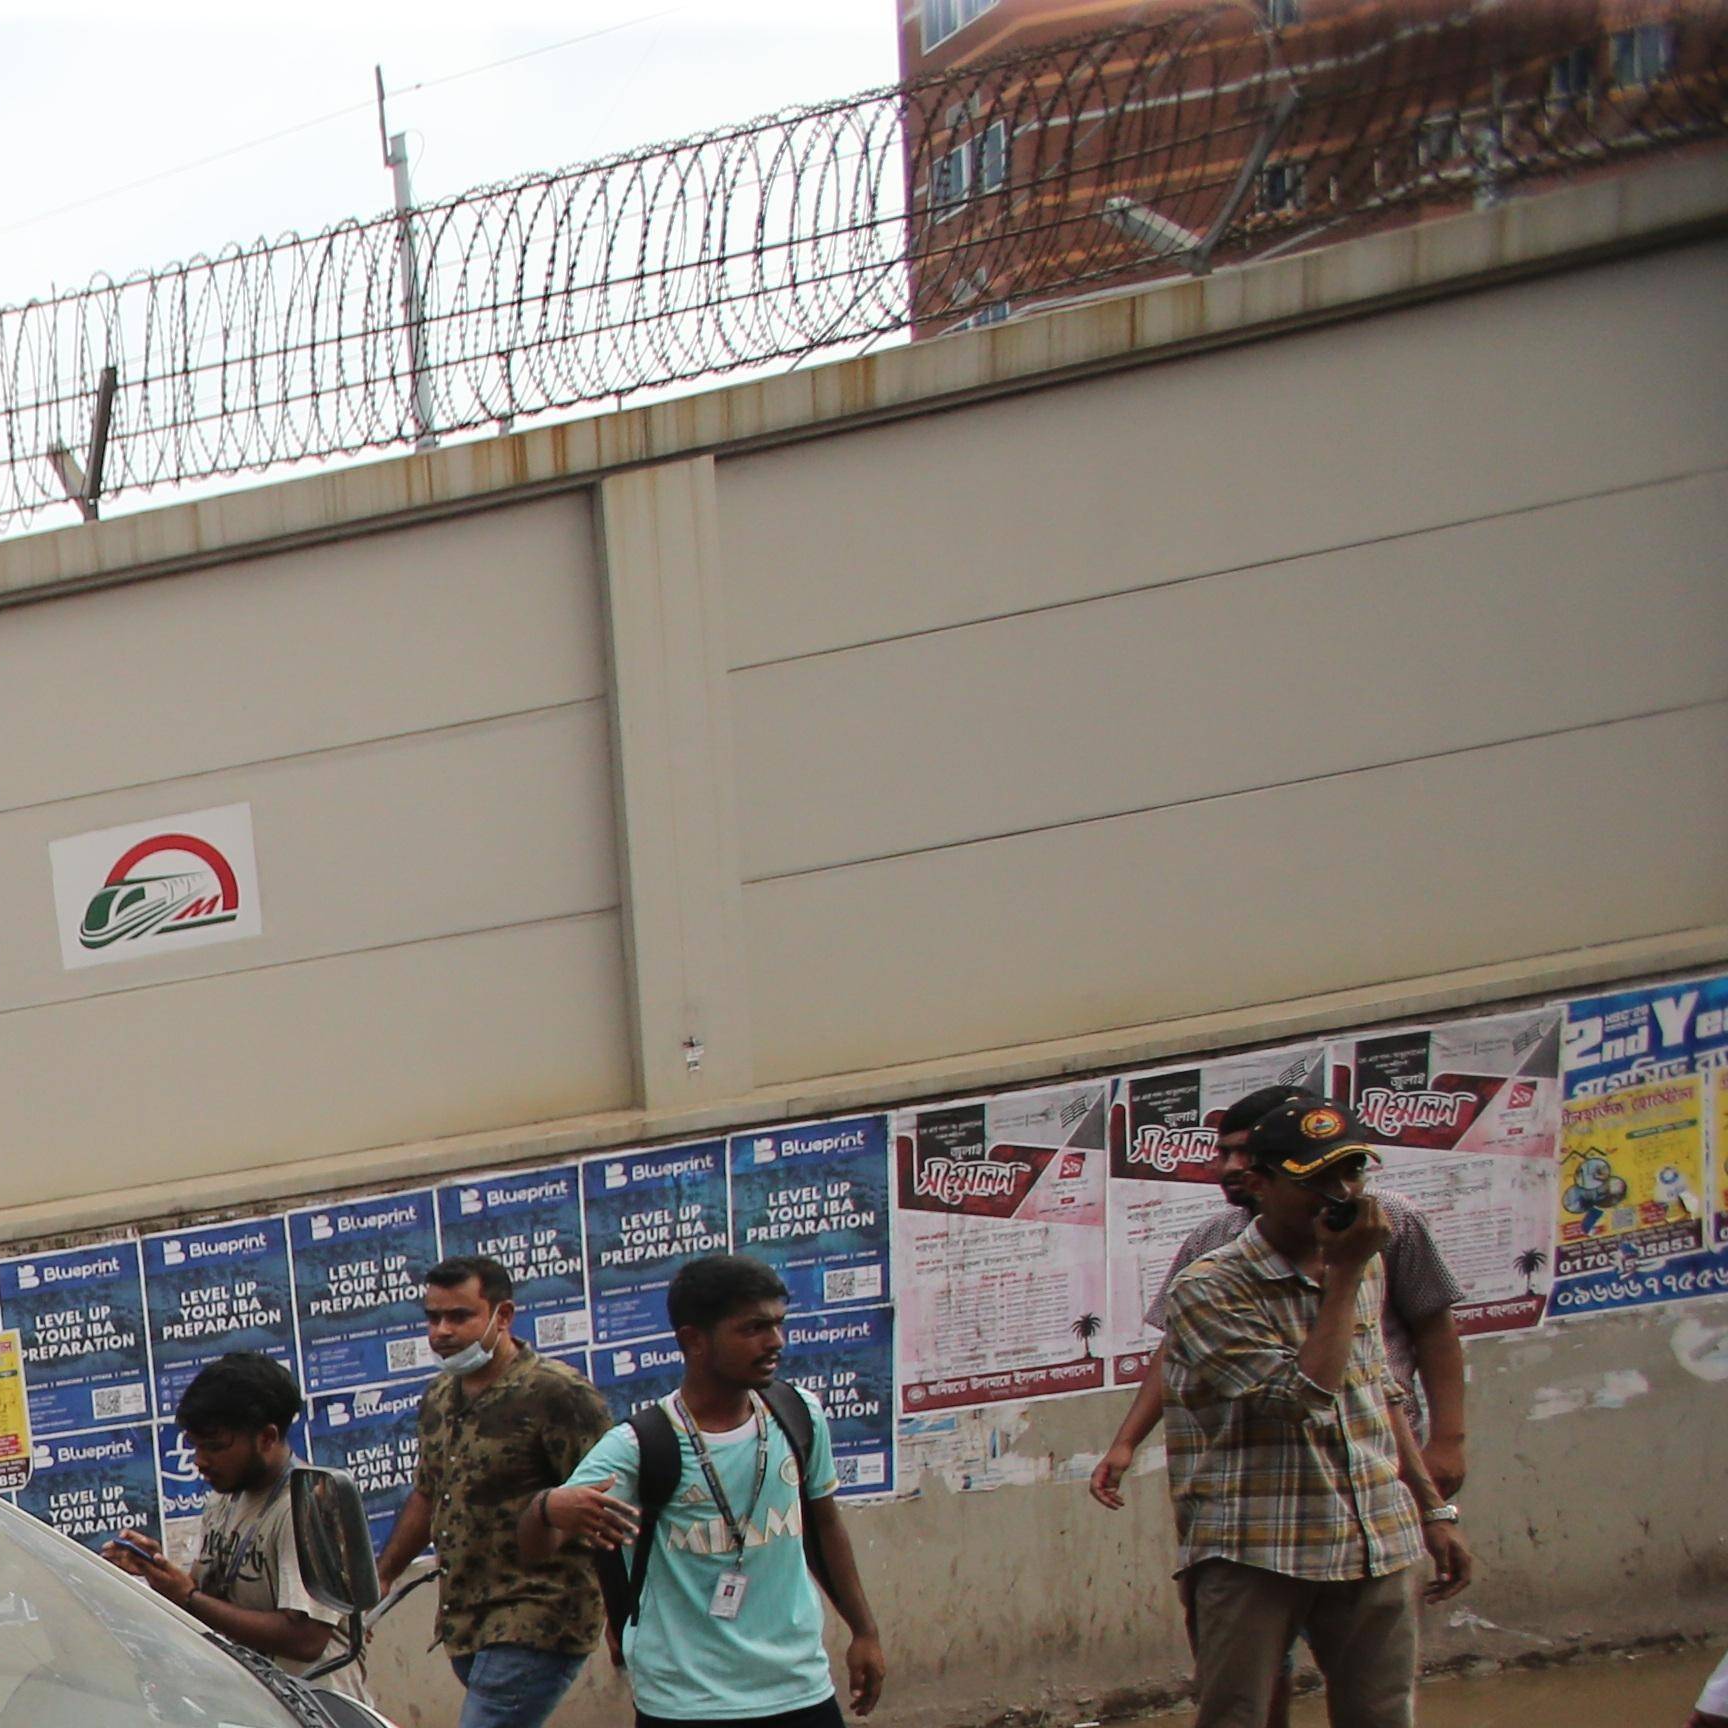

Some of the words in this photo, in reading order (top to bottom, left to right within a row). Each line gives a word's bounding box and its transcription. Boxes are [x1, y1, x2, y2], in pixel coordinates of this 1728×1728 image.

[1651, 990, 1728, 1047] Ye
[1563, 1015, 1649, 1072] 2nd
[781, 1130, 864, 1156] Blueprint
[632, 1154, 714, 1182] Blueprint
[486, 1180, 568, 1207] Blueprint
[768, 1187, 821, 1207] LEVEL
[827, 1181, 851, 1196] UP
[337, 1206, 417, 1233] Blueprint
[621, 1210, 673, 1231] LEVEL
[679, 1205, 702, 1220] UP
[767, 1202, 818, 1222] YOUR
[823, 1198, 855, 1214] IBA
[620, 1226, 672, 1246] YOUR
[675, 1221, 706, 1237] IBA
[746, 1211, 875, 1242] PREPARATION
[189, 1232, 267, 1258] Blueprint
[478, 1234, 529, 1255] LEVEL
[534, 1229, 557, 1245] UP
[601, 1232, 727, 1266] PREPARATION
[329, 1261, 379, 1281] LEVEL
[384, 1255, 407, 1271] UP
[489, 1250, 526, 1268] OUR
[531, 1245, 562, 1262] IBA
[43, 1257, 120, 1282] Blueprint
[181, 1286, 229, 1306] LEVEL
[235, 1282, 257, 1297] UP
[328, 1276, 376, 1296] YOUR
[382, 1272, 411, 1287] IBA
[179, 1302, 230, 1321] YOUR
[233, 1297, 262, 1312] IBA
[310, 1284, 430, 1316] PREPARATION
[35, 1310, 84, 1330] LEVEL
[89, 1305, 111, 1321] UP
[163, 1309, 281, 1340] PREPARATION
[35, 1325, 84, 1345] YOUR
[87, 1320, 116, 1336] IBA
[788, 1321, 871, 1345] Blueprint
[21, 1333, 135, 1362] PREPARATION
[832, 1372, 856, 1387] UP
[829, 1389, 859, 1404] IBA
[58, 1439, 133, 1463] Blueprint
[347, 1446, 394, 1467] LEVEL
[346, 1462, 392, 1481] YOUR
[50, 1490, 97, 1509] LEVEL
[102, 1485, 124, 1500] UP
[48, 1504, 95, 1523] YOUR
[100, 1500, 129, 1515] IBA
[55, 1512, 148, 1536] EPARATION
